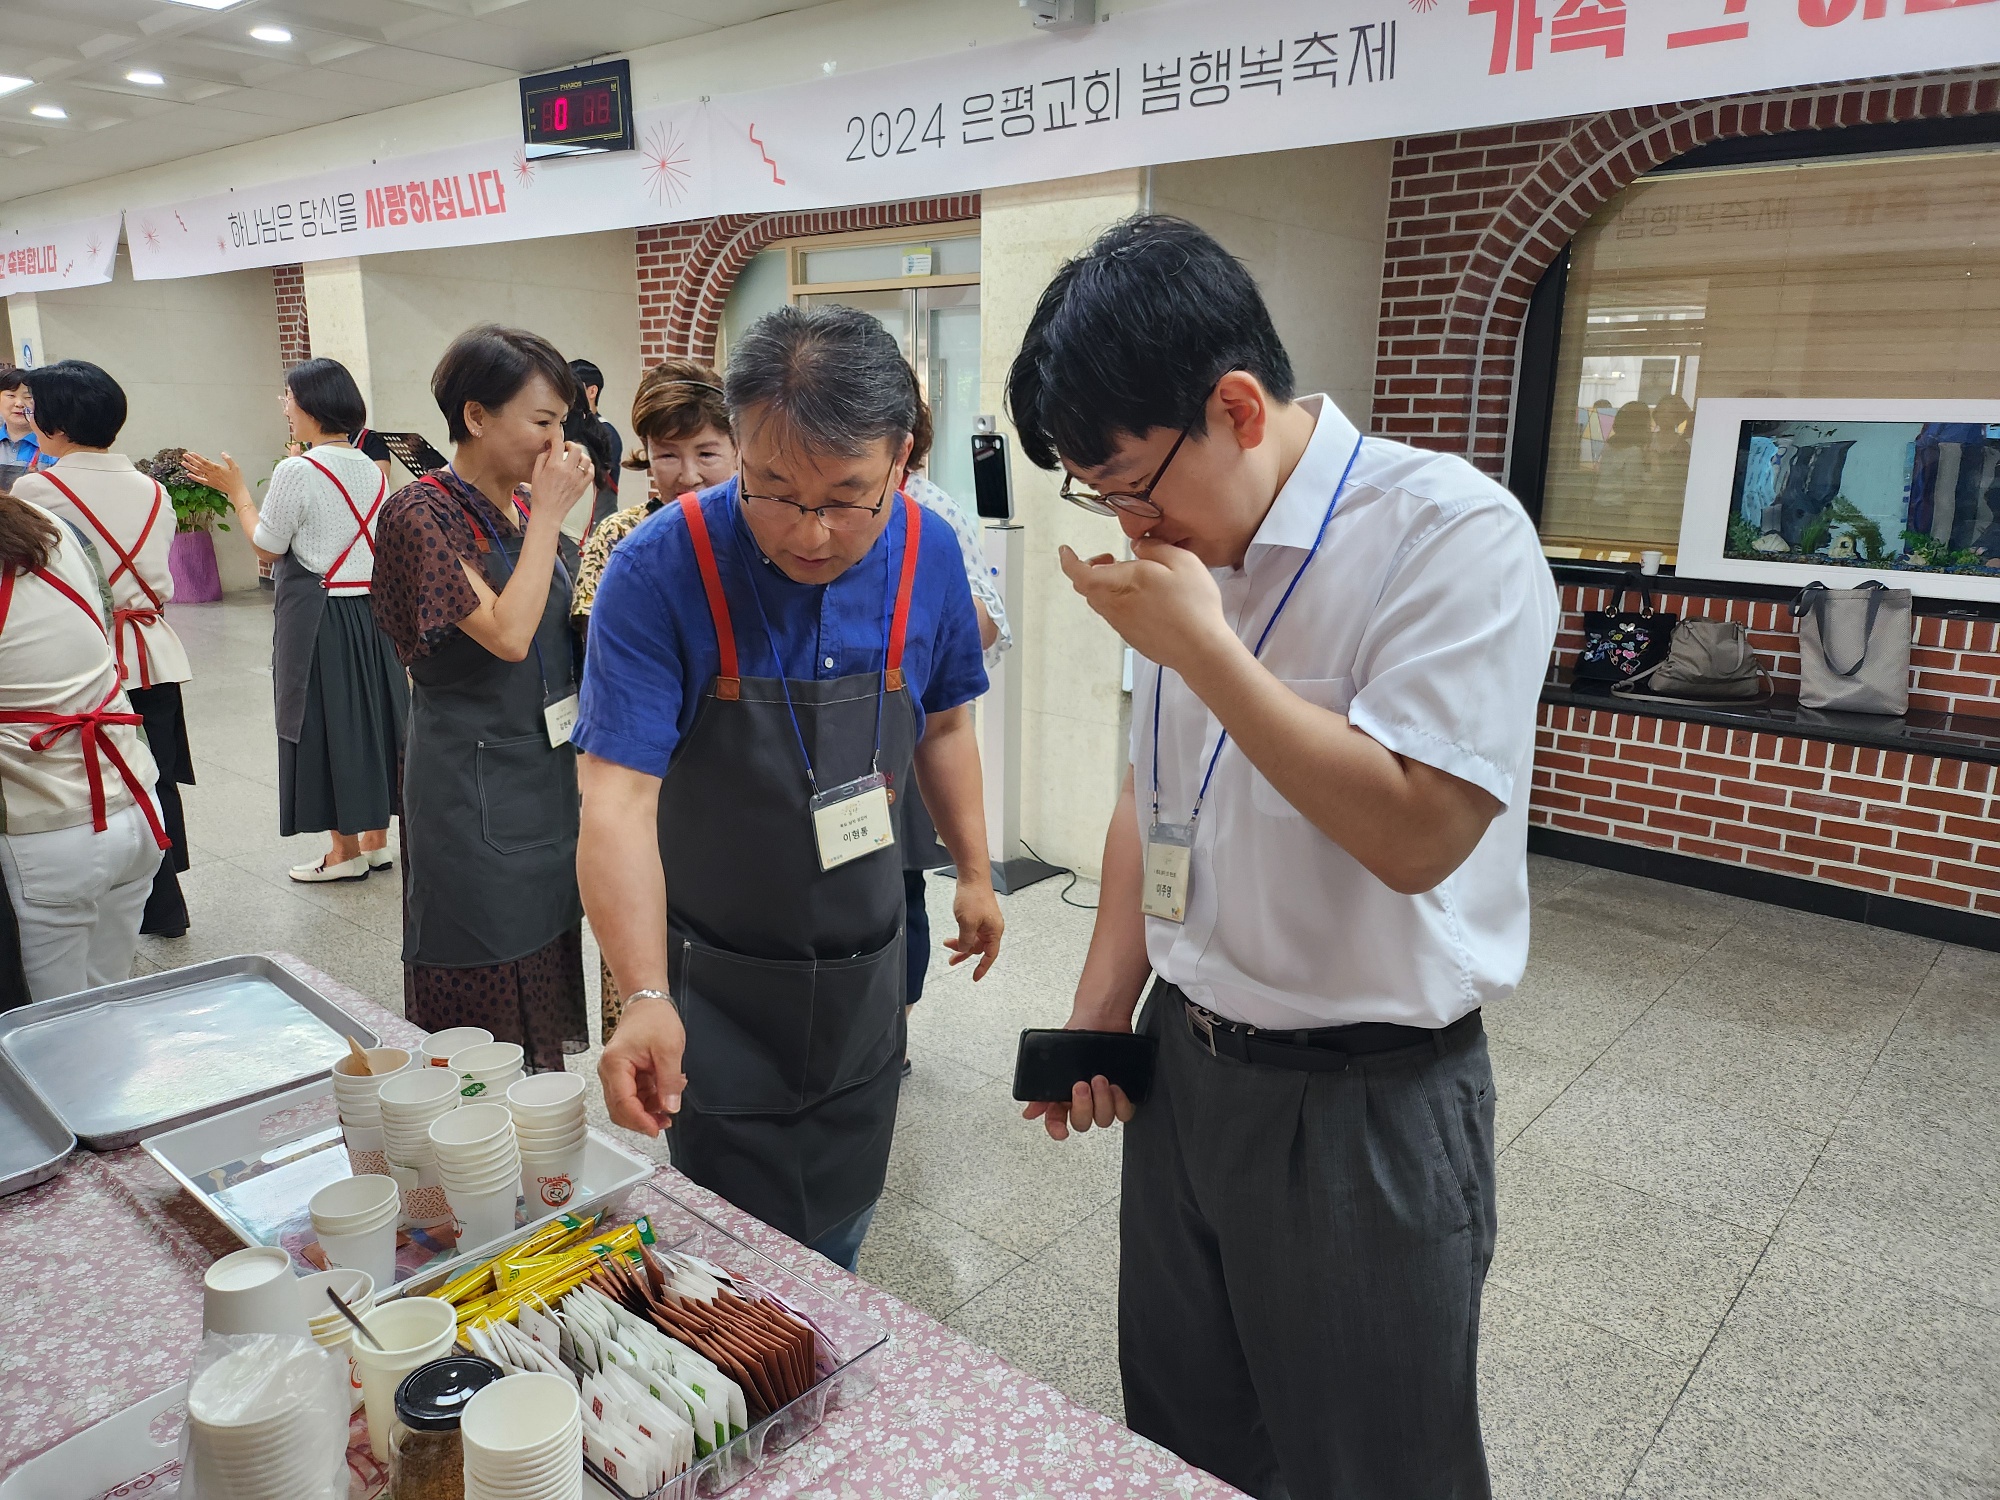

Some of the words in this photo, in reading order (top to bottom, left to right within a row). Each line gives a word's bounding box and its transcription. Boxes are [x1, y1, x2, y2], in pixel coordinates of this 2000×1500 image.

[559, 81, 582, 91] PHAROS
[846, 102, 946, 162] 2024
[962, 66, 1121, 145] 은평교회
[1142, 20, 1396, 116] 봄행복축제
[227, 203, 295, 248] 하나님은
[299, 192, 358, 237] 당신을
[365, 169, 507, 230] 사랑하십니다
[8, 244, 58, 277] 축복합니다
[537, 1172, 569, 1184] Classic
